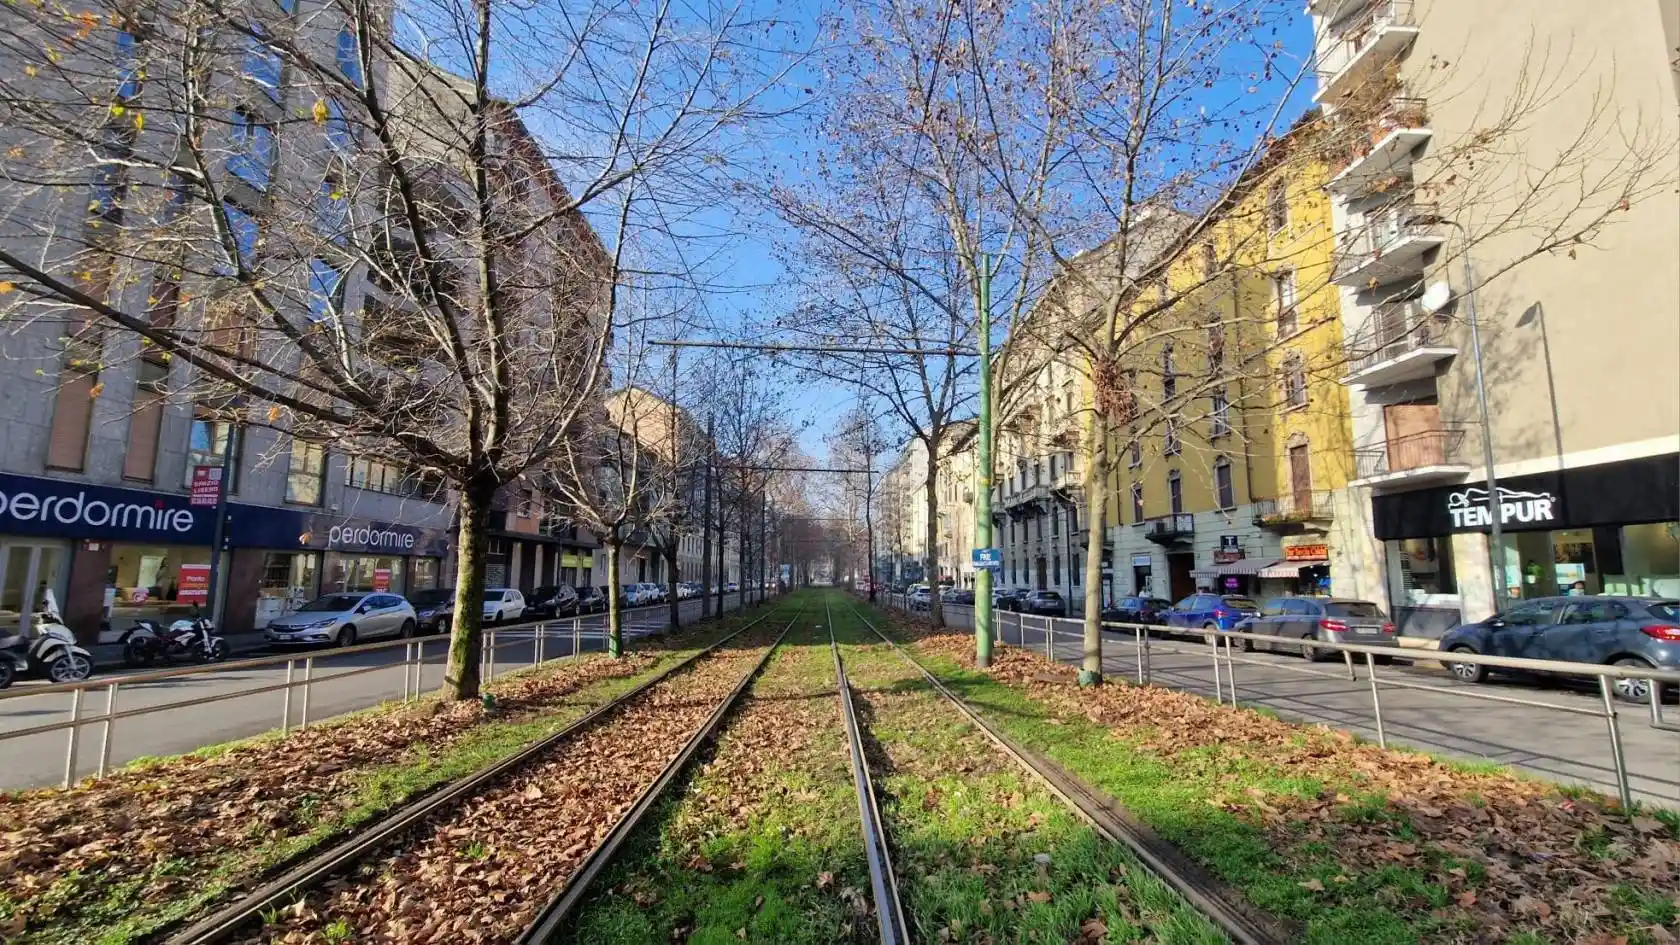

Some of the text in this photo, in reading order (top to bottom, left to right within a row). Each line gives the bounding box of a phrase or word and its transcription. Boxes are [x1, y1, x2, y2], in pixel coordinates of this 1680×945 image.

[0, 491, 194, 532] erdormire
[1450, 499, 1554, 528] TEMPUR
[328, 525, 415, 549] perdormire
